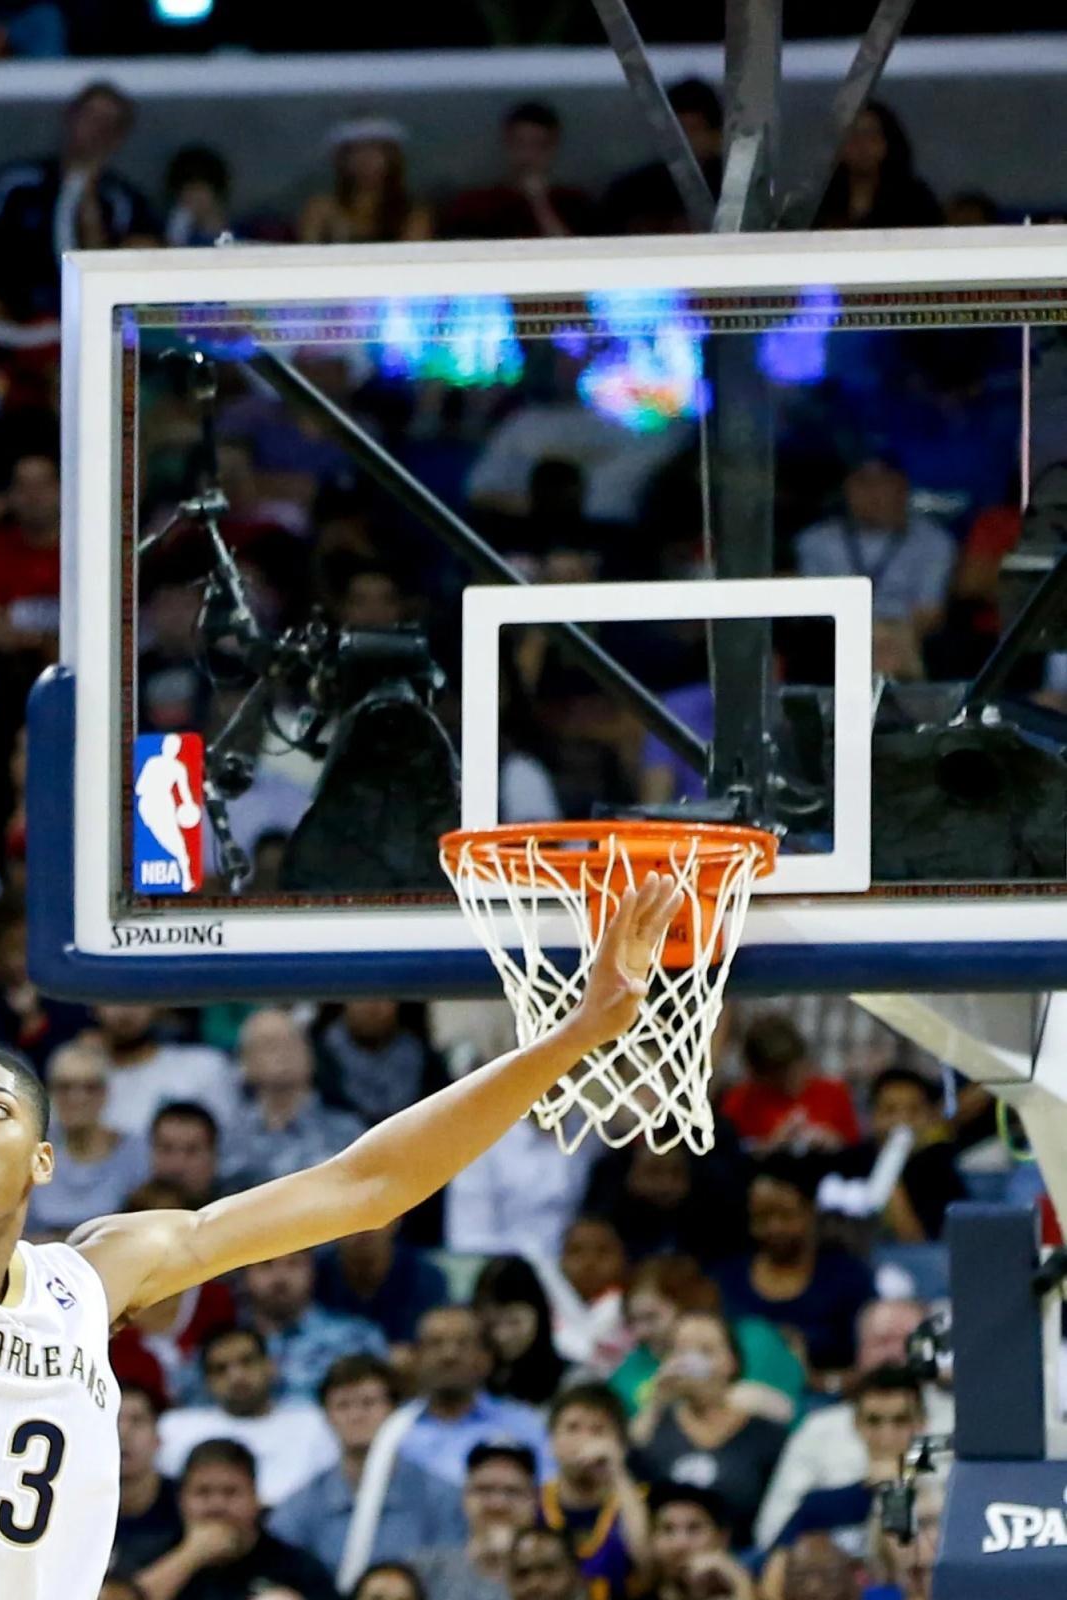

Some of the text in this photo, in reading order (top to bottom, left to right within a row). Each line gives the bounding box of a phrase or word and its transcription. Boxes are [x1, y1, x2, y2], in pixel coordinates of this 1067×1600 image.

[140, 860, 182, 885] NBA
[111, 921, 225, 949] SPALDING
[981, 1502, 1067, 1554] SPA
